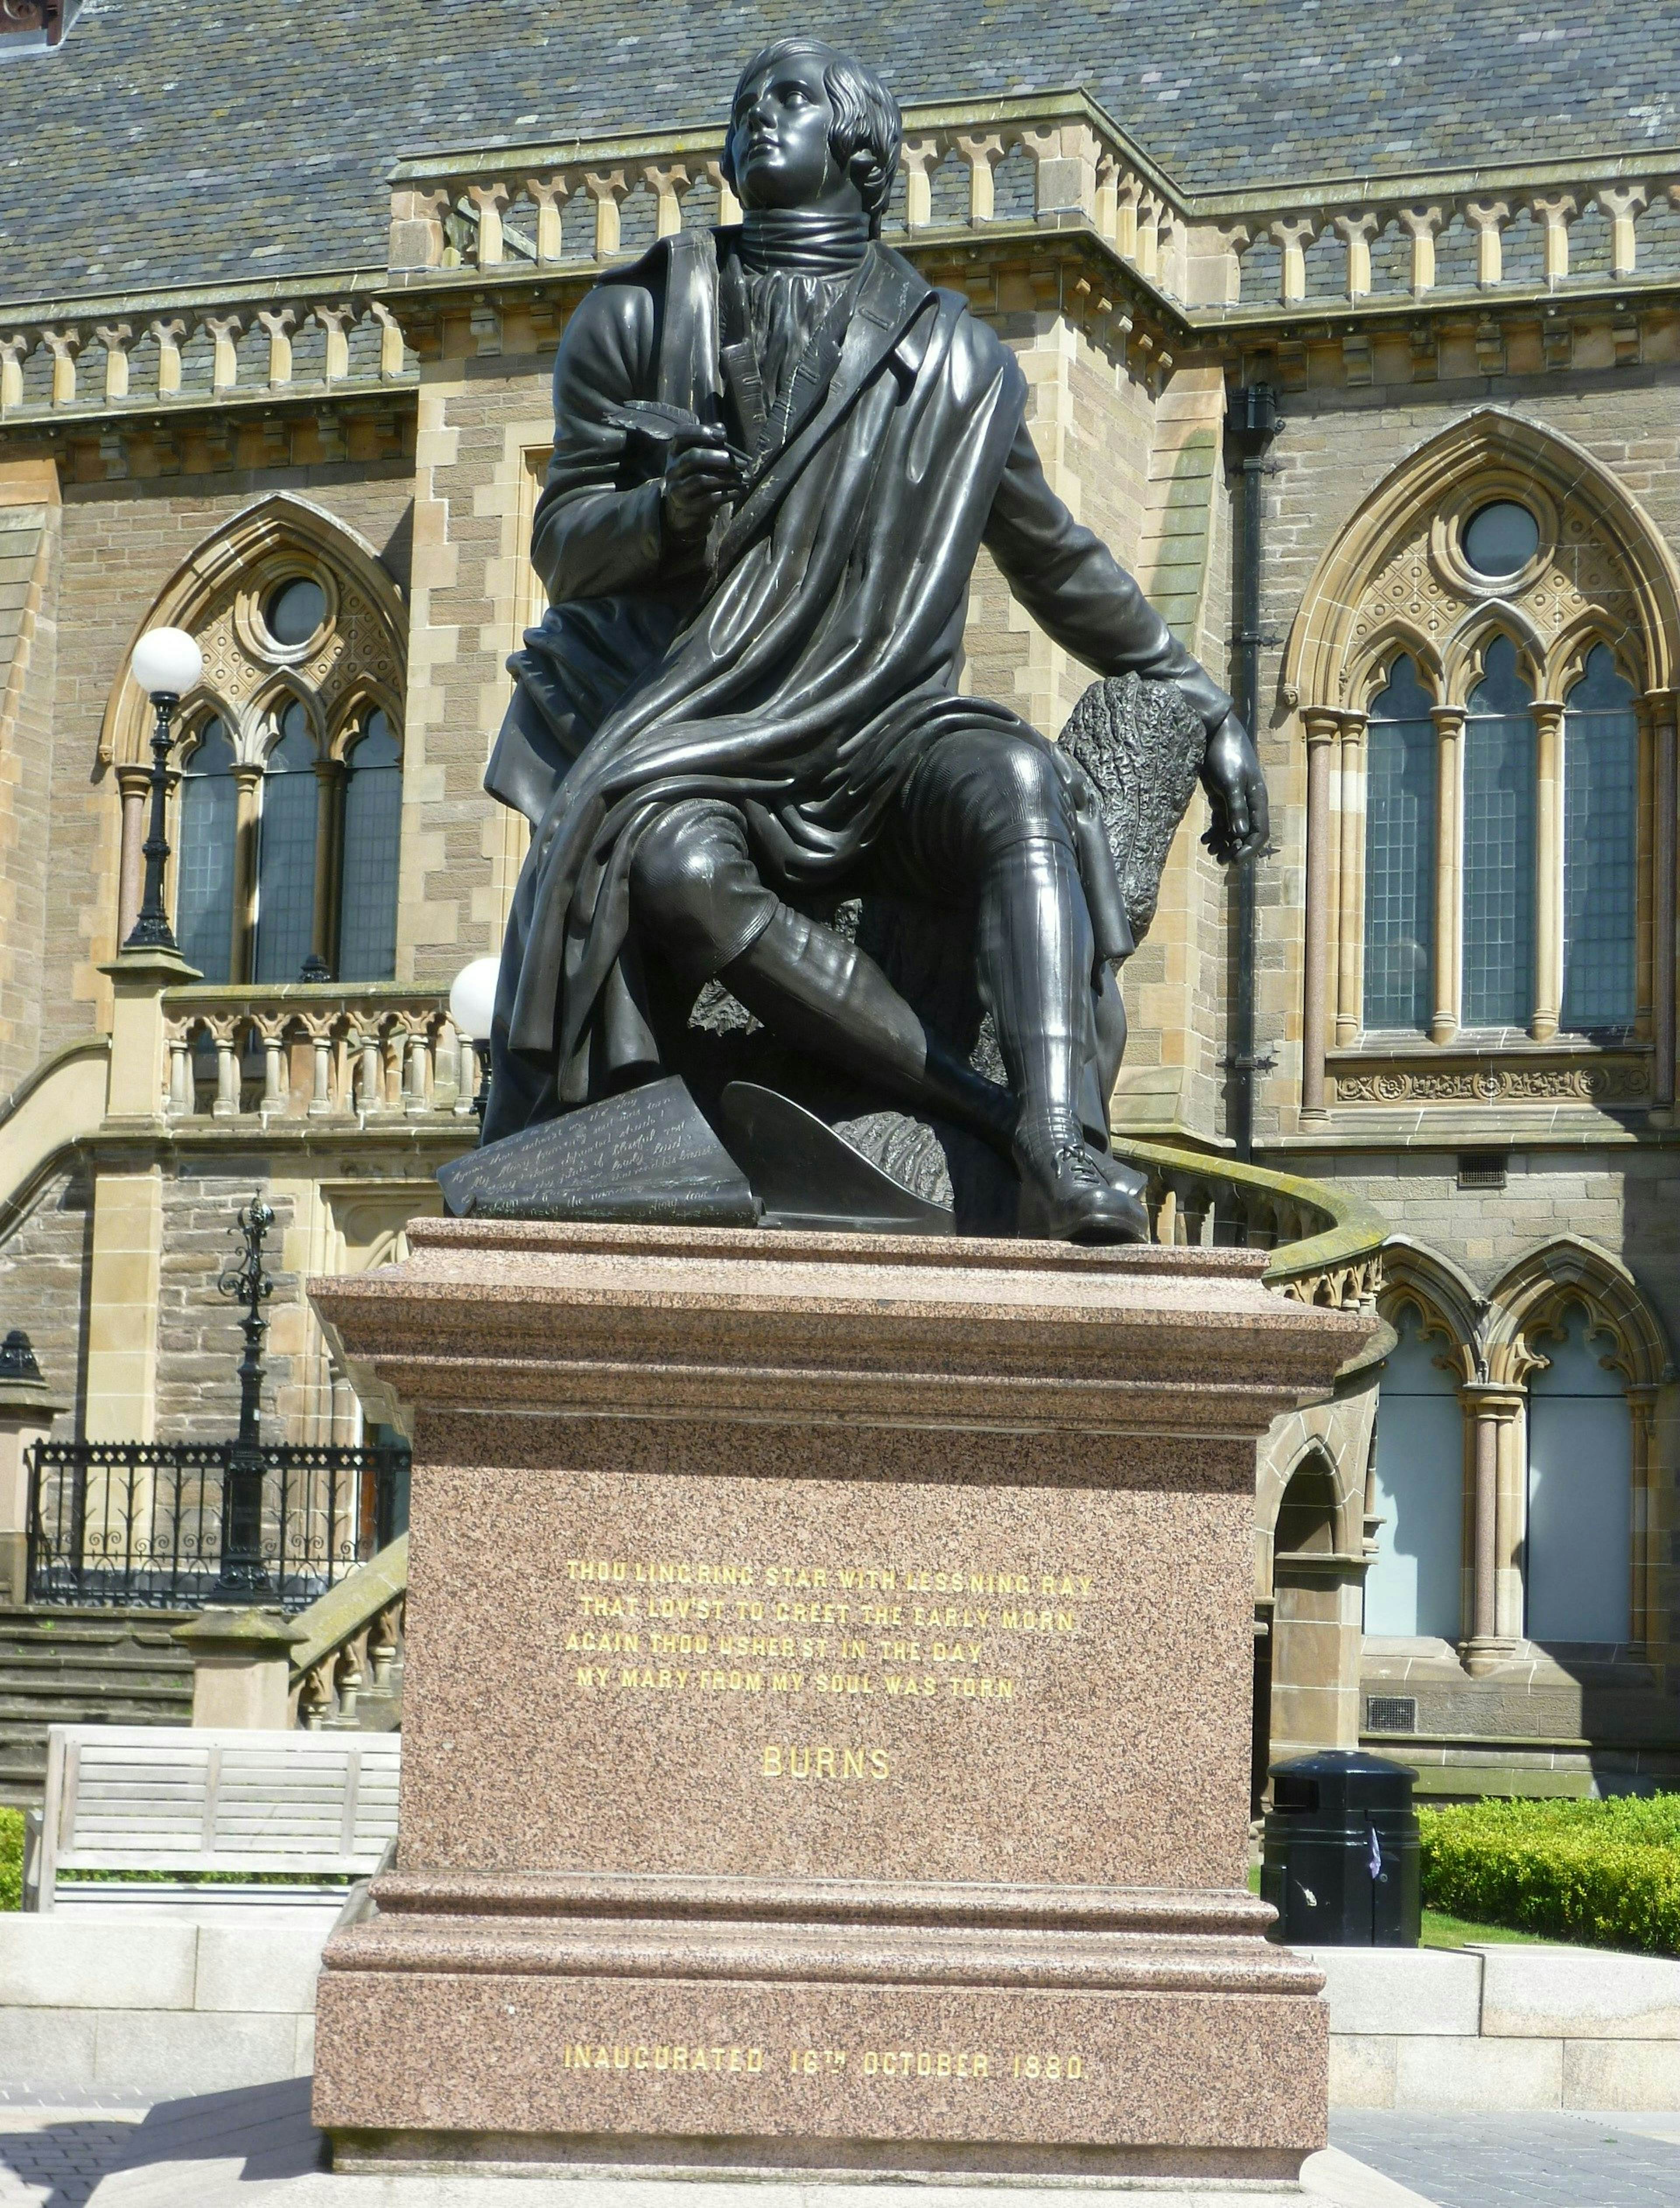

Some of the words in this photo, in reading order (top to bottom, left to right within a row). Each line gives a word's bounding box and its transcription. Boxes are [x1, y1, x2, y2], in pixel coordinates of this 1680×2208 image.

[567, 1561, 626, 1581] THOU
[766, 1566, 827, 1587] STAR
[838, 1569, 896, 1590] WITH
[1041, 1575, 1092, 1595] RAY
[581, 1596, 638, 1617] THAT
[648, 1597, 724, 1619] LOV'ST
[736, 1601, 763, 1620] TO
[777, 1602, 849, 1623] GREET
[861, 1605, 901, 1625] THE
[915, 1607, 989, 1629] EARLY
[1002, 1610, 1074, 1631] MORN
[566, 1633, 638, 1652] AGAIN
[651, 1633, 709, 1654] THOU
[842, 1640, 866, 1659] IN
[881, 1641, 920, 1661] THE
[933, 1643, 981, 1663] DAY
[577, 1667, 610, 1686] MY
[622, 1669, 689, 1689] MARY
[700, 1670, 760, 1691] FROM
[773, 1672, 803, 1692] MY
[817, 1674, 874, 1693] SOUL
[885, 1675, 936, 1696] WAS
[949, 1677, 1014, 1698] TORN
[763, 1745, 890, 1780] BURNS
[564, 2044, 763, 2072] INAUGURATED
[864, 2051, 988, 2078] OCTOBER
